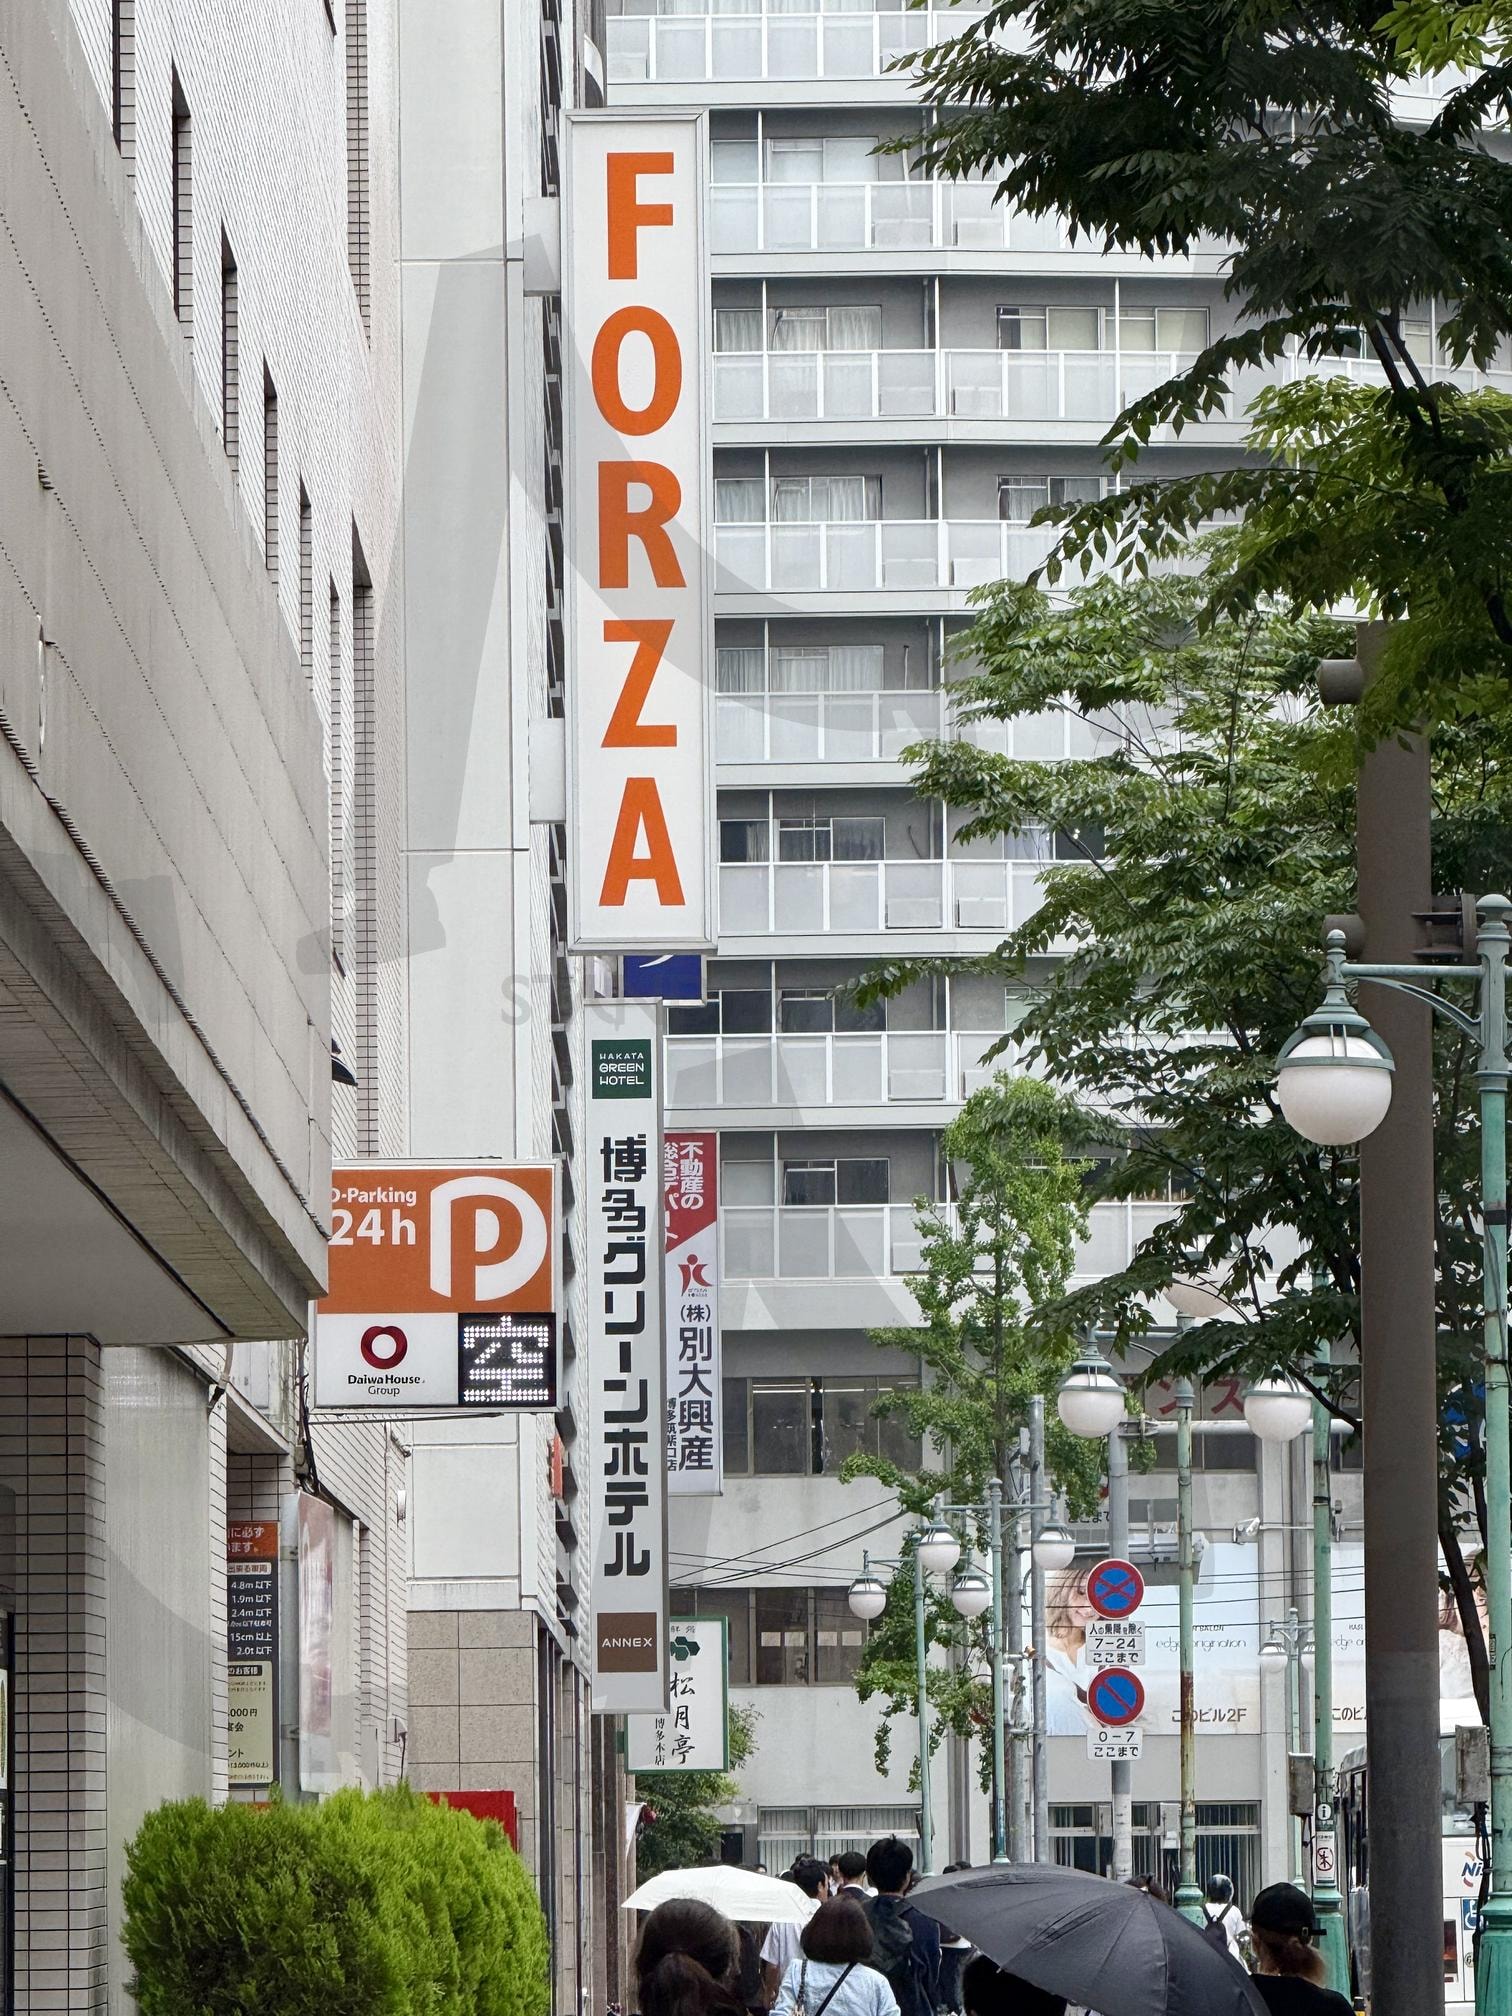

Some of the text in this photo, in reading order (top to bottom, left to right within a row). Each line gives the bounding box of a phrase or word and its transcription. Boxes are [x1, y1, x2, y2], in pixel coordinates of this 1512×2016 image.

[591, 151, 687, 907] FORZA
[600, 1052, 644, 1060] HAKATA
[600, 1063, 644, 1073] GREEN
[600, 1075, 644, 1085] HOTEL
[680, 1141, 704, 1210] 不動産の
[328, 1208, 416, 1245] 24h
[463, 1315, 549, 1402] 空
[600, 1133, 650, 1577] 博多グリーンホテル
[368, 1385, 400, 1397] Group
[1089, 1623, 1143, 1635] 人の乗降を除く
[601, 1637, 653, 1648] ANNEX
[1095, 1638, 1136, 1649] 7-24
[1156, 1635, 1180, 1652] edg
[1093, 1652, 1139, 1663] ここまで
[670, 1671, 696, 1764] 松月亭
[1098, 1731, 1135, 1743] 0-7
[1094, 1746, 1139, 1758] ここまで
